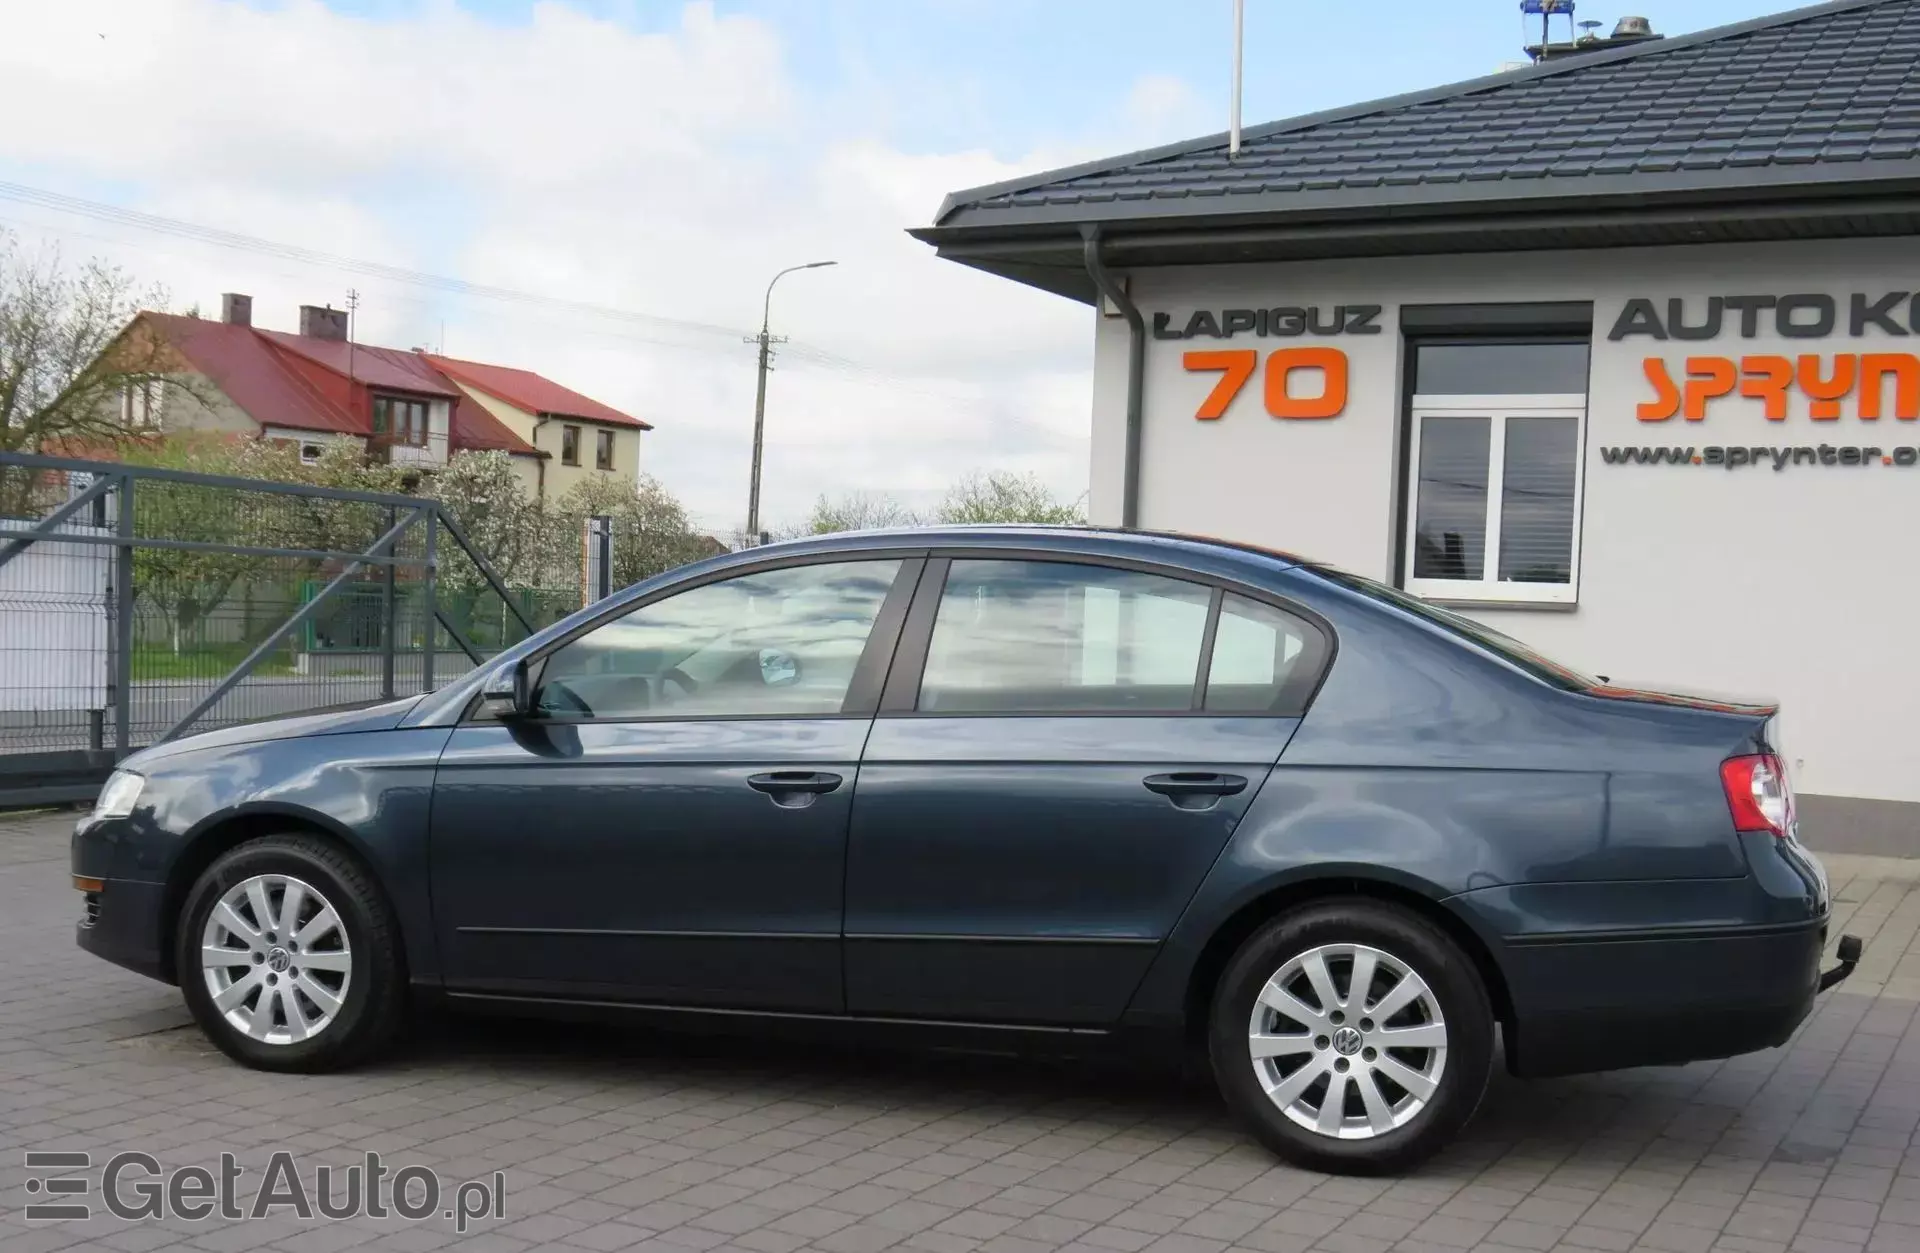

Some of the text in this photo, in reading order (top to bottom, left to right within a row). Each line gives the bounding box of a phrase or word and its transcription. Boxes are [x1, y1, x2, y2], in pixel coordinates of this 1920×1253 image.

[1607, 291, 1920, 341] AUTO K
[1183, 347, 1349, 420] 70
[1600, 444, 1920, 471] www.sprynter.o
